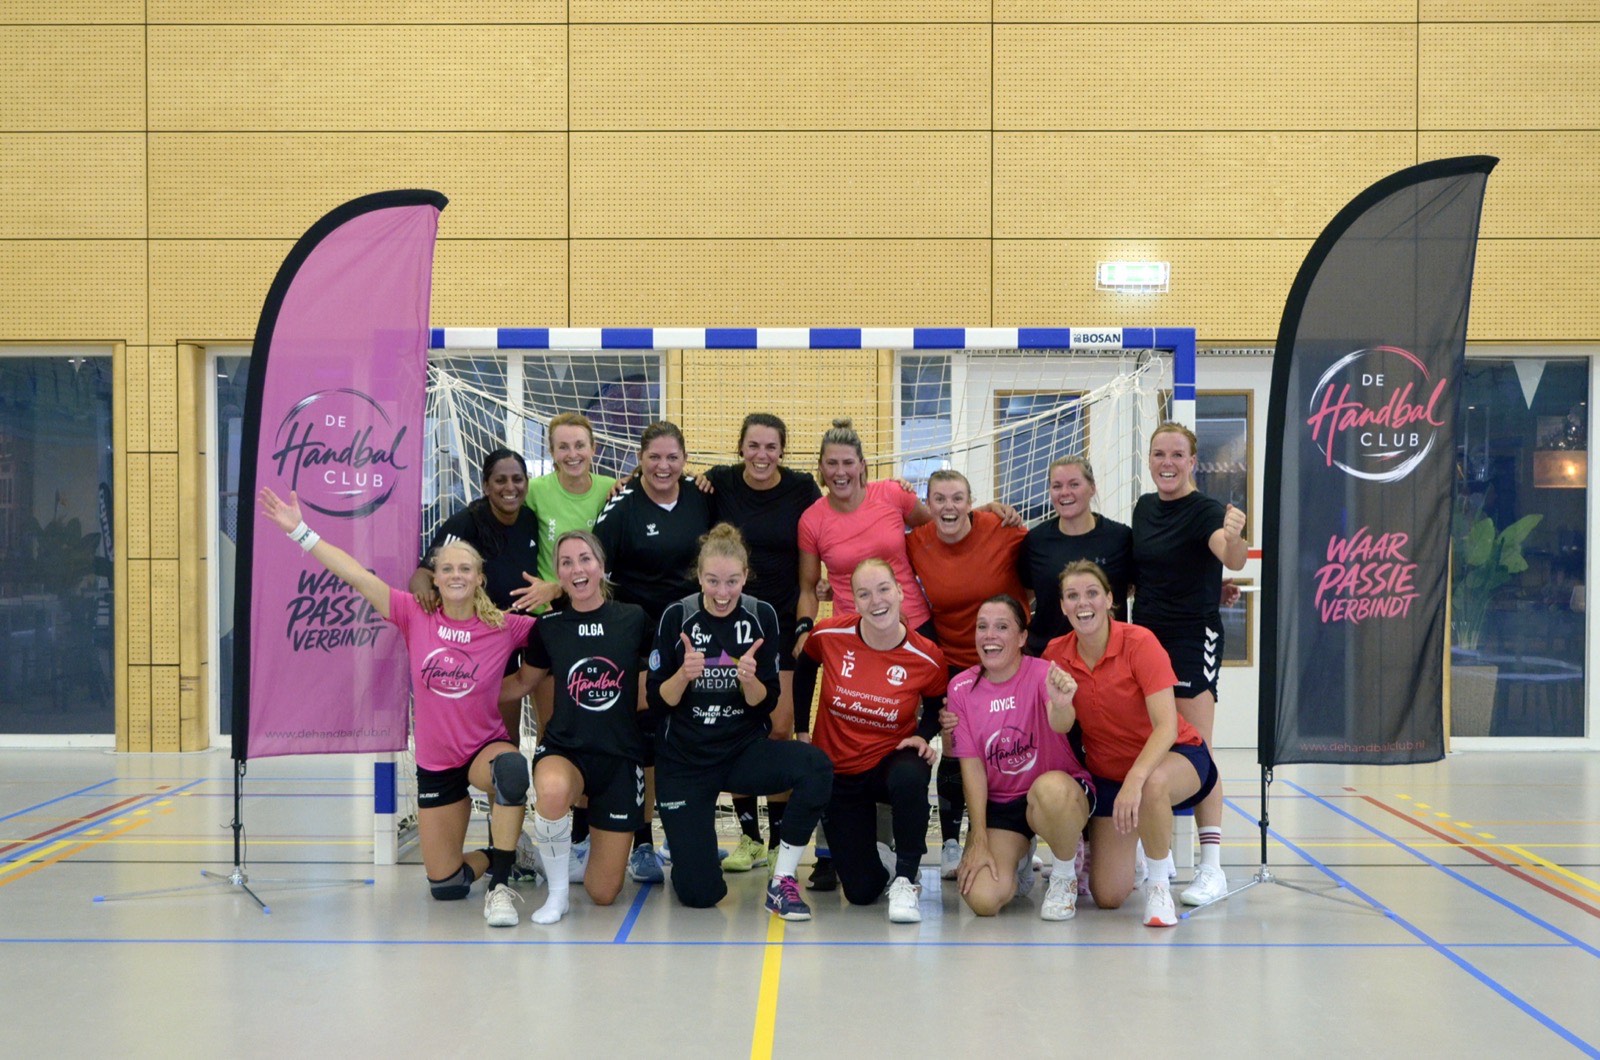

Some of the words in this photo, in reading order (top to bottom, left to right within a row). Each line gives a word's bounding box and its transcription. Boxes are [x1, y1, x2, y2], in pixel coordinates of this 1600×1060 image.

[1082, 333, 1121, 343] BOSAN
[1362, 373, 1385, 386] DE
[325, 414, 347, 428] DE
[1307, 378, 1447, 467] Handbal
[1360, 432, 1419, 447] CLUB
[272, 421, 408, 491] Handbal
[324, 470, 383, 487] CLUB
[1326, 526, 1410, 563] WAAR
[1314, 562, 1418, 610] PASSIE
[1321, 594, 1420, 625] VERBINDT
[437, 625, 471, 644] MAYRA
[578, 623, 605, 636] OLGA
[734, 620, 754, 644] 12
[294, 625, 388, 653] VERBINDT
[444, 656, 454, 664] DE
[841, 660, 855, 678] 12
[421, 657, 480, 690] Handbal
[700, 668, 738, 678] BOVO
[441, 679, 468, 689] CLUB
[567, 670, 625, 706] Handbal
[695, 679, 737, 689] MEDIA
[835, 685, 900, 705] TRANSPORTBEDRIJF
[989, 695, 1016, 713] JOYCE
[692, 706, 721, 718] Simon
[832, 696, 847, 708] Ton
[848, 701, 899, 722] Brandhoff
[265, 728, 391, 739] www.dehandbalclub.nl
[987, 732, 1038, 773] Handbal
[1299, 740, 1425, 753] www.dehandbalclub.nl
[1008, 752, 1032, 765] CLUB
